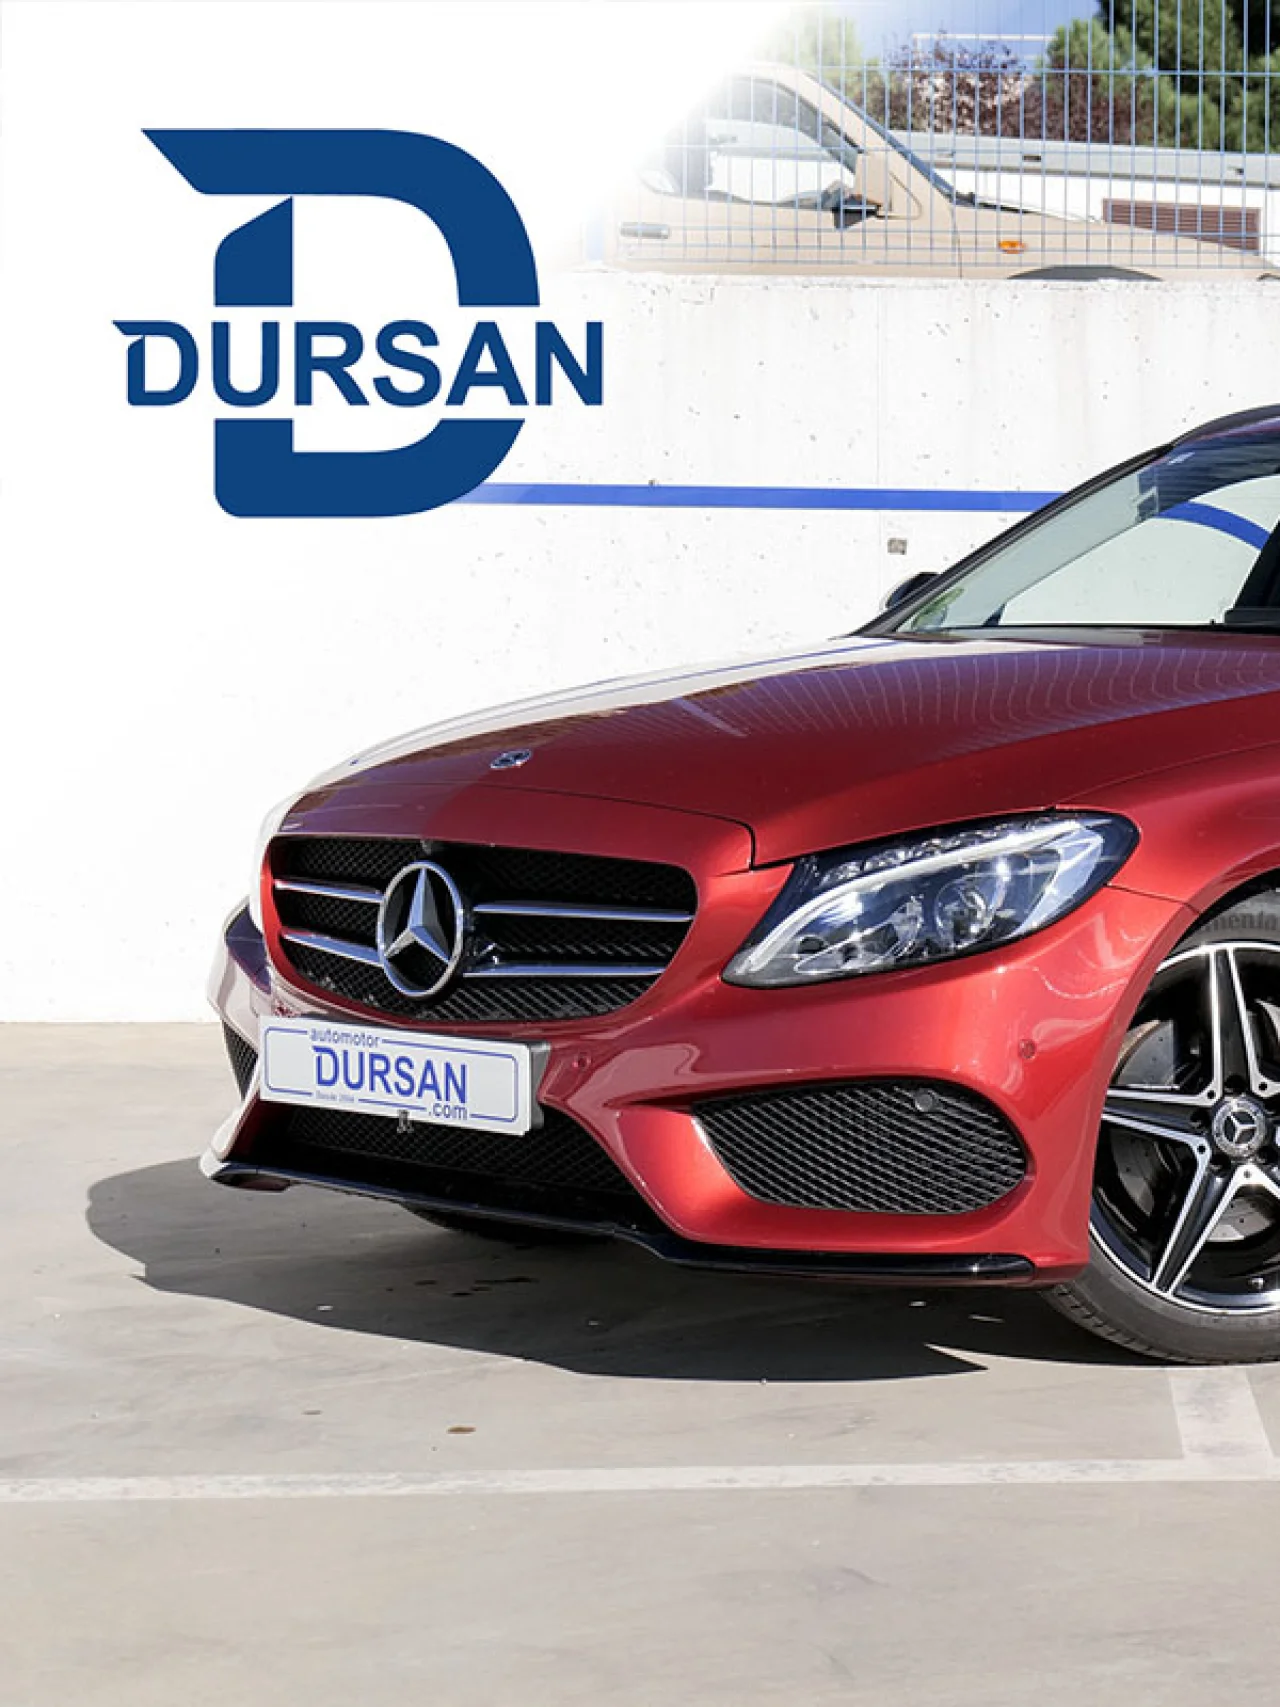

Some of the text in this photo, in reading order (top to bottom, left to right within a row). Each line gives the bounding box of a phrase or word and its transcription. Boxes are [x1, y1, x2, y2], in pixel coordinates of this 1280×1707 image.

[310, 1028, 380, 1048] automotor
[312, 1045, 467, 1104] DURSAN
[428, 1102, 468, 1121] .com
